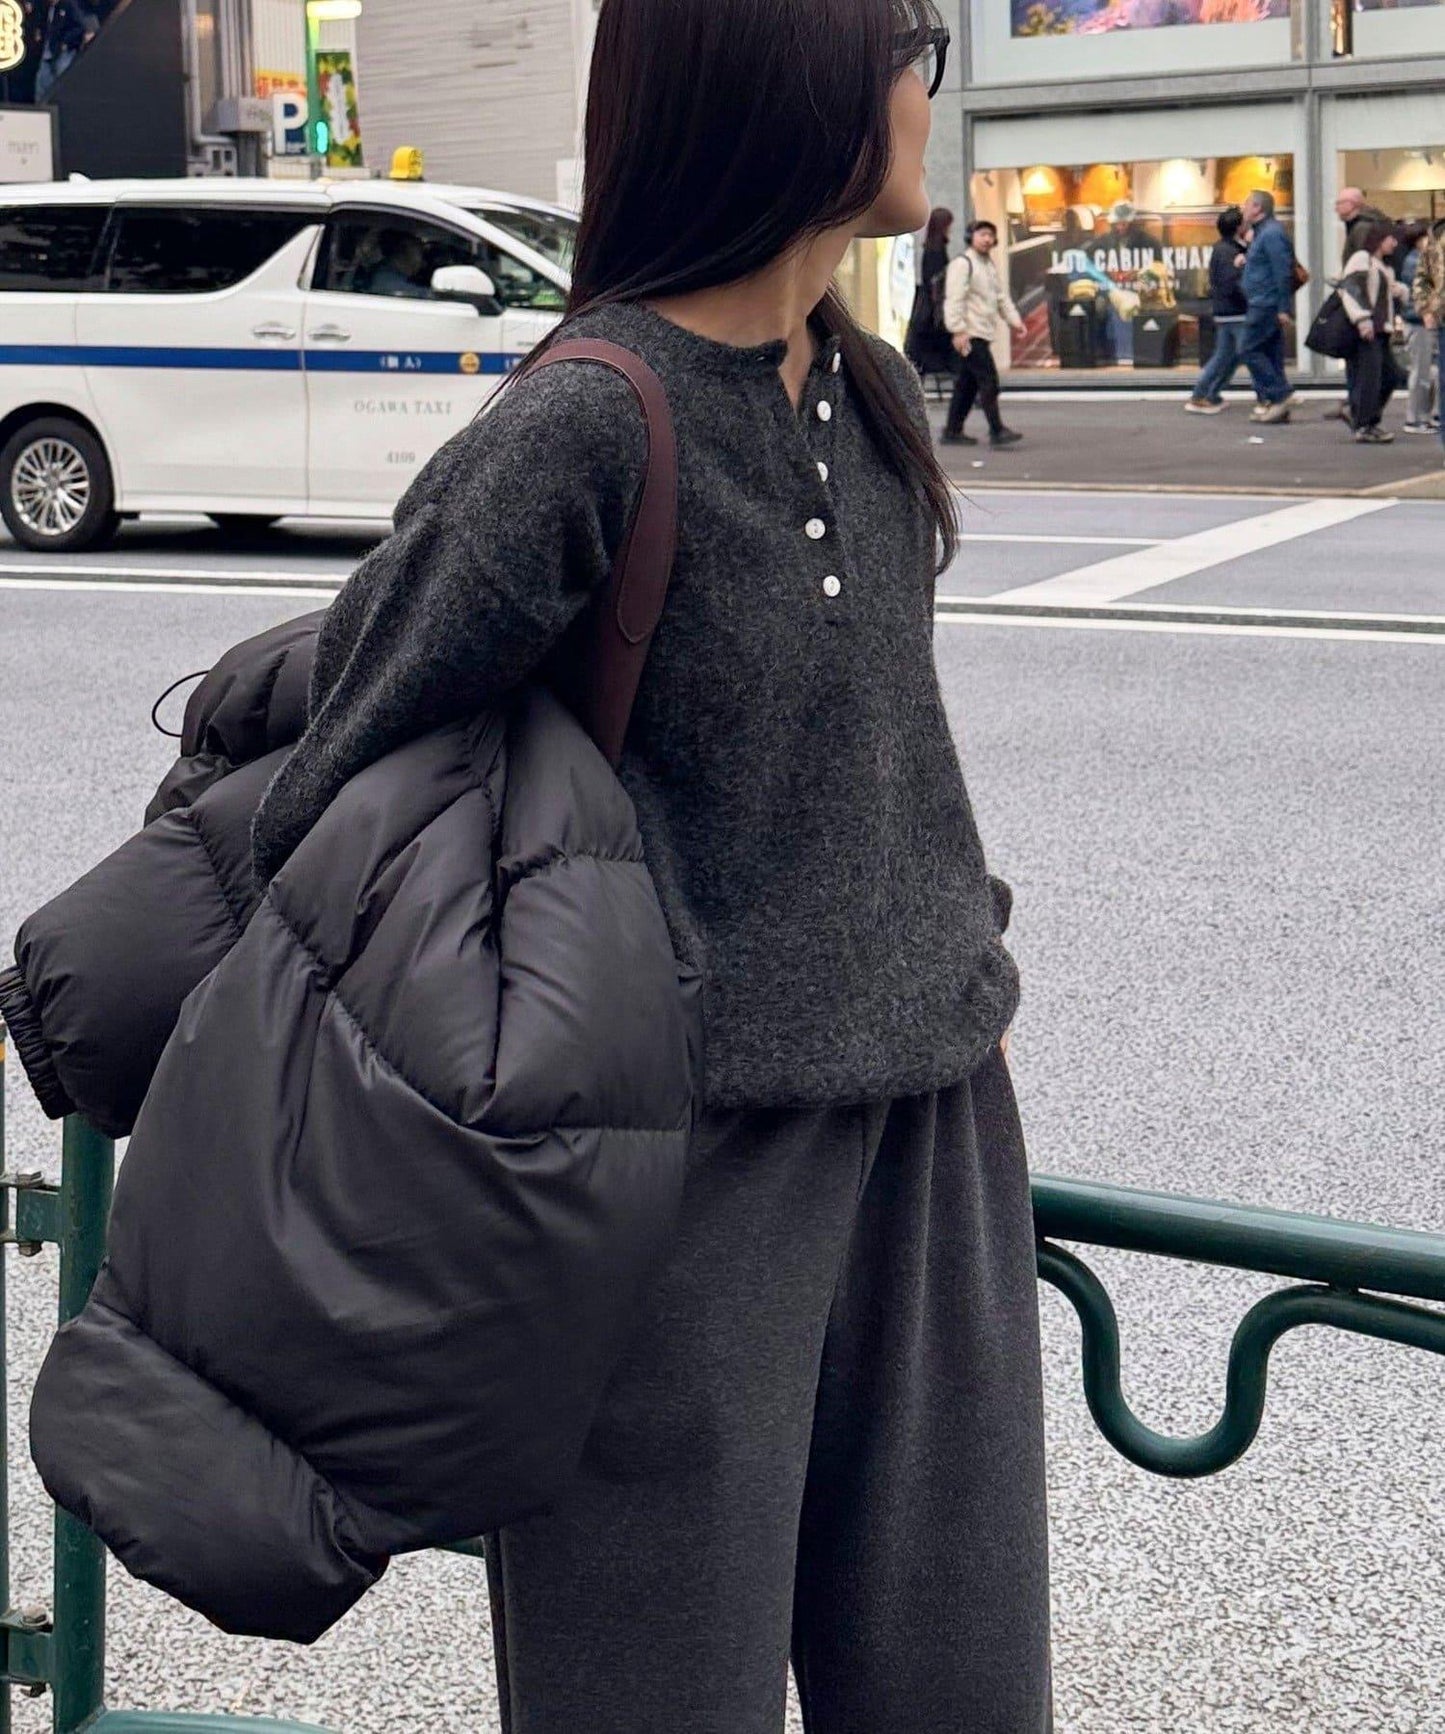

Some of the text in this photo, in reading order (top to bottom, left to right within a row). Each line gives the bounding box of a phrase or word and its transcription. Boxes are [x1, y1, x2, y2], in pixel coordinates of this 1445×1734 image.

[273, 93, 309, 154] P
[1094, 247, 1155, 273] CABIN
[354, 400, 452, 416] OGAWA TAXI
